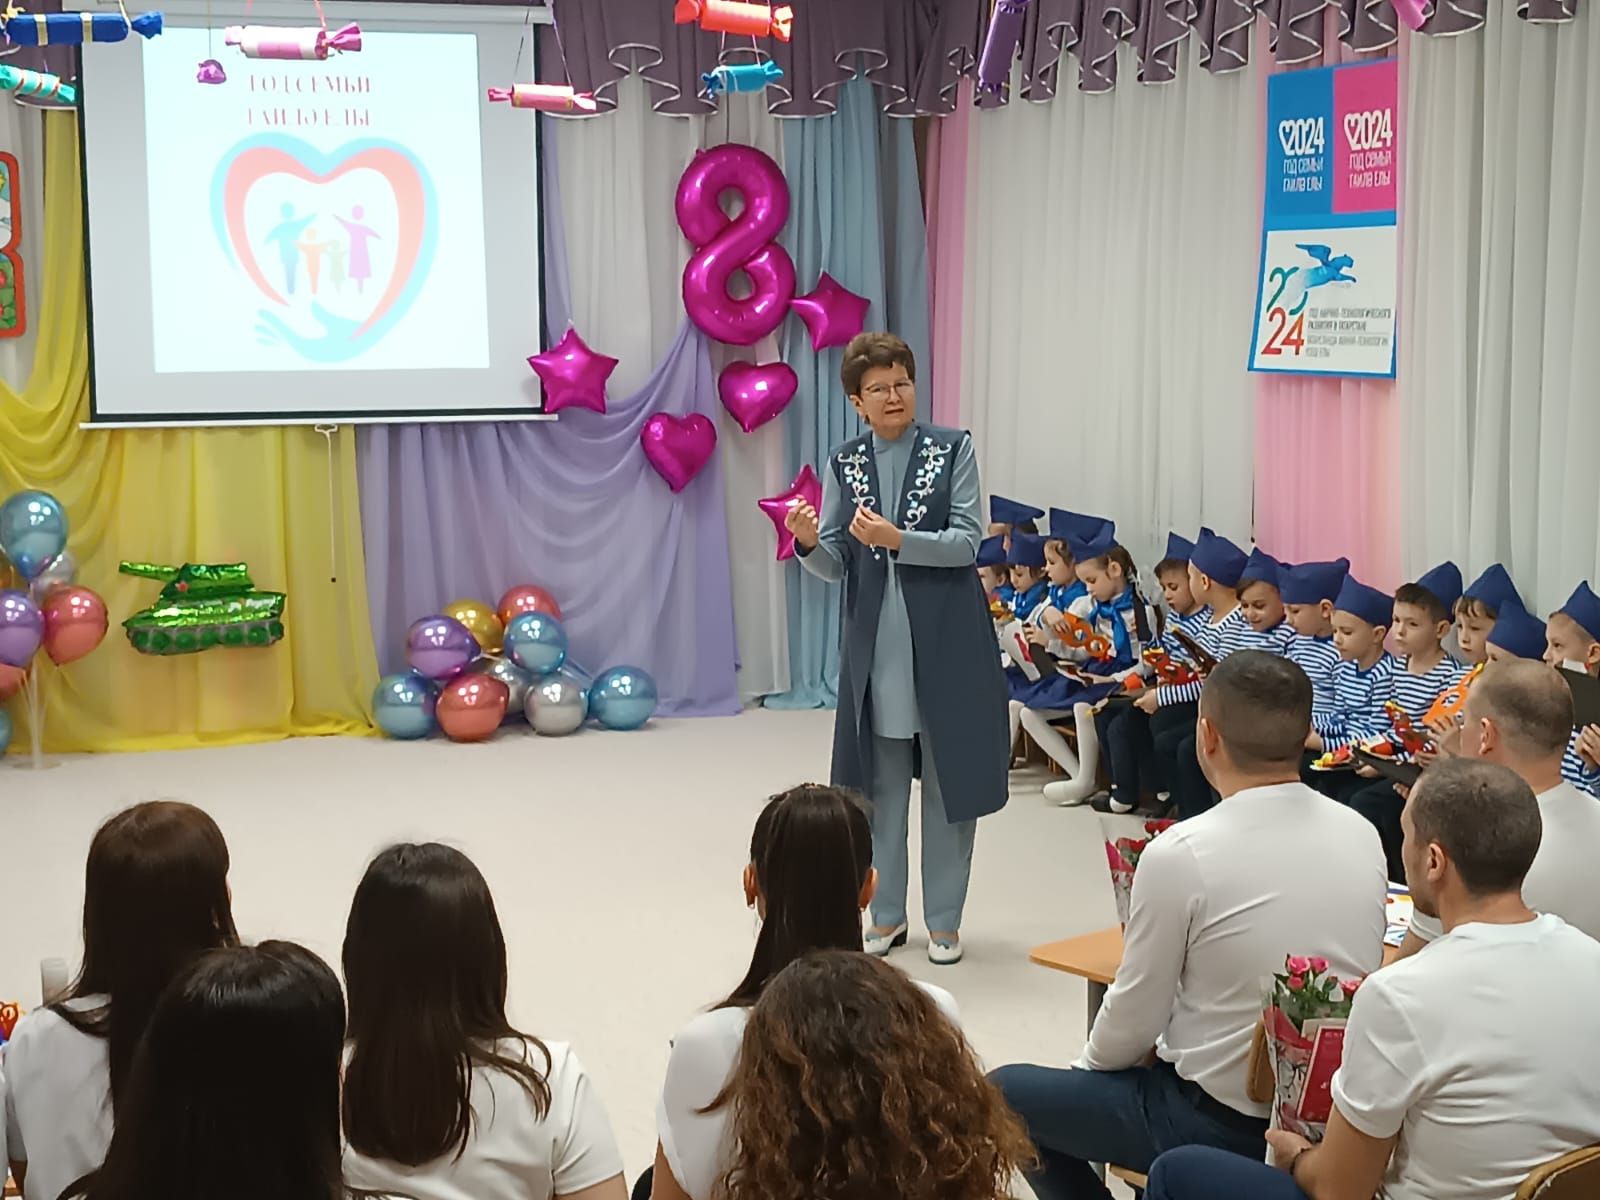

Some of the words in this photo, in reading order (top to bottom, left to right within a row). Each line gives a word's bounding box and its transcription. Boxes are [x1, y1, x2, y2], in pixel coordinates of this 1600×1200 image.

[1282, 116, 1325, 156] 2024
[1347, 108, 1393, 151] 2024
[1283, 158, 1297, 176] ГОД
[1349, 153, 1365, 171] ГОД
[675, 143, 796, 345] 8
[1261, 307, 1304, 355] 24
